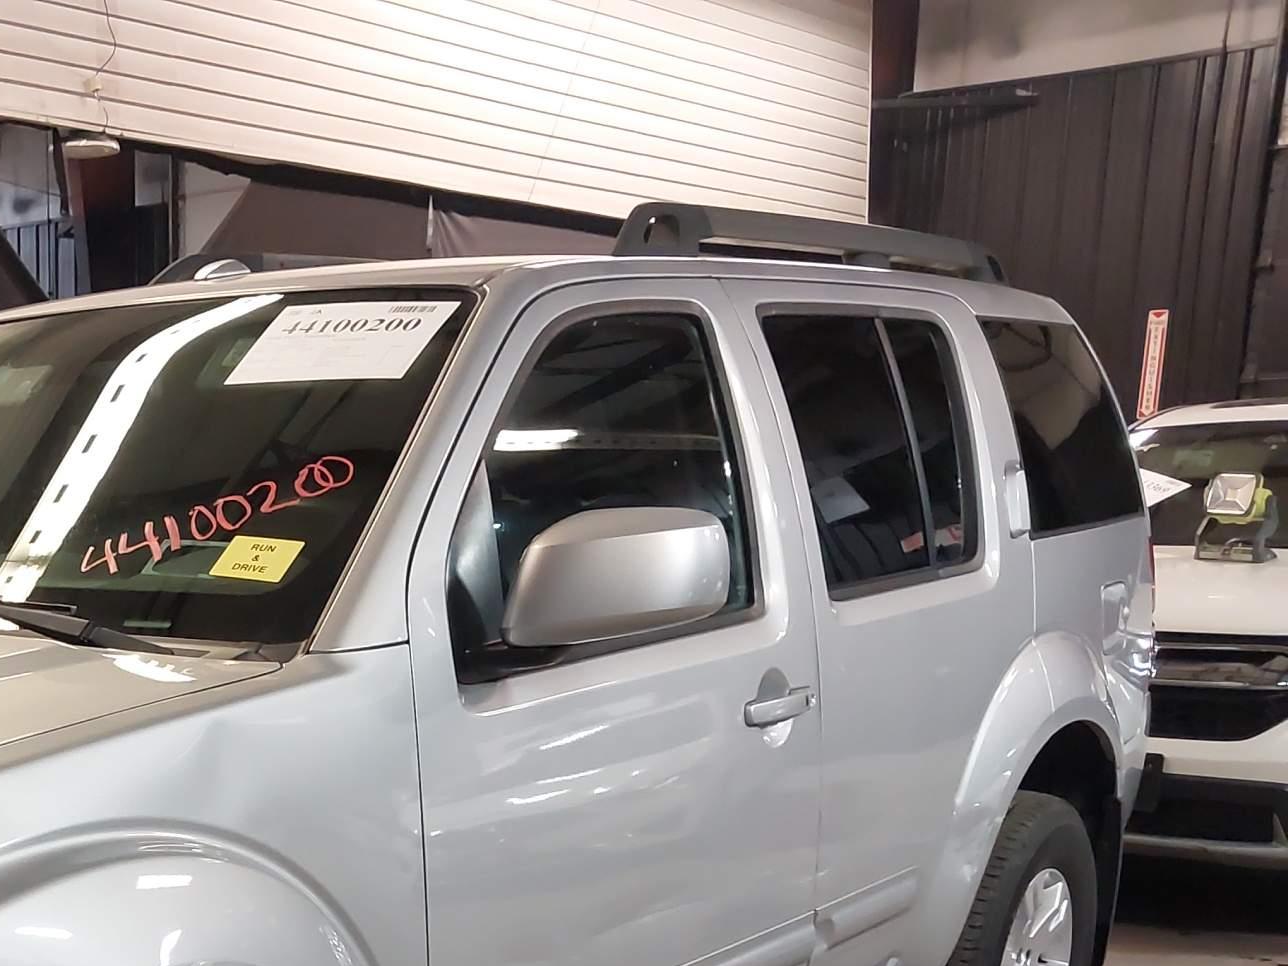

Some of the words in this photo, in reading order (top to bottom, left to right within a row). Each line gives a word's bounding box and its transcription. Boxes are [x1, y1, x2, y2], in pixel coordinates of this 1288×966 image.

[282, 318, 422, 335] 44100200
[80, 456, 354, 574] 44100200
[250, 543, 277, 553] RUN
[251, 554, 260, 562] &
[231, 562, 268, 574] DRIVE
